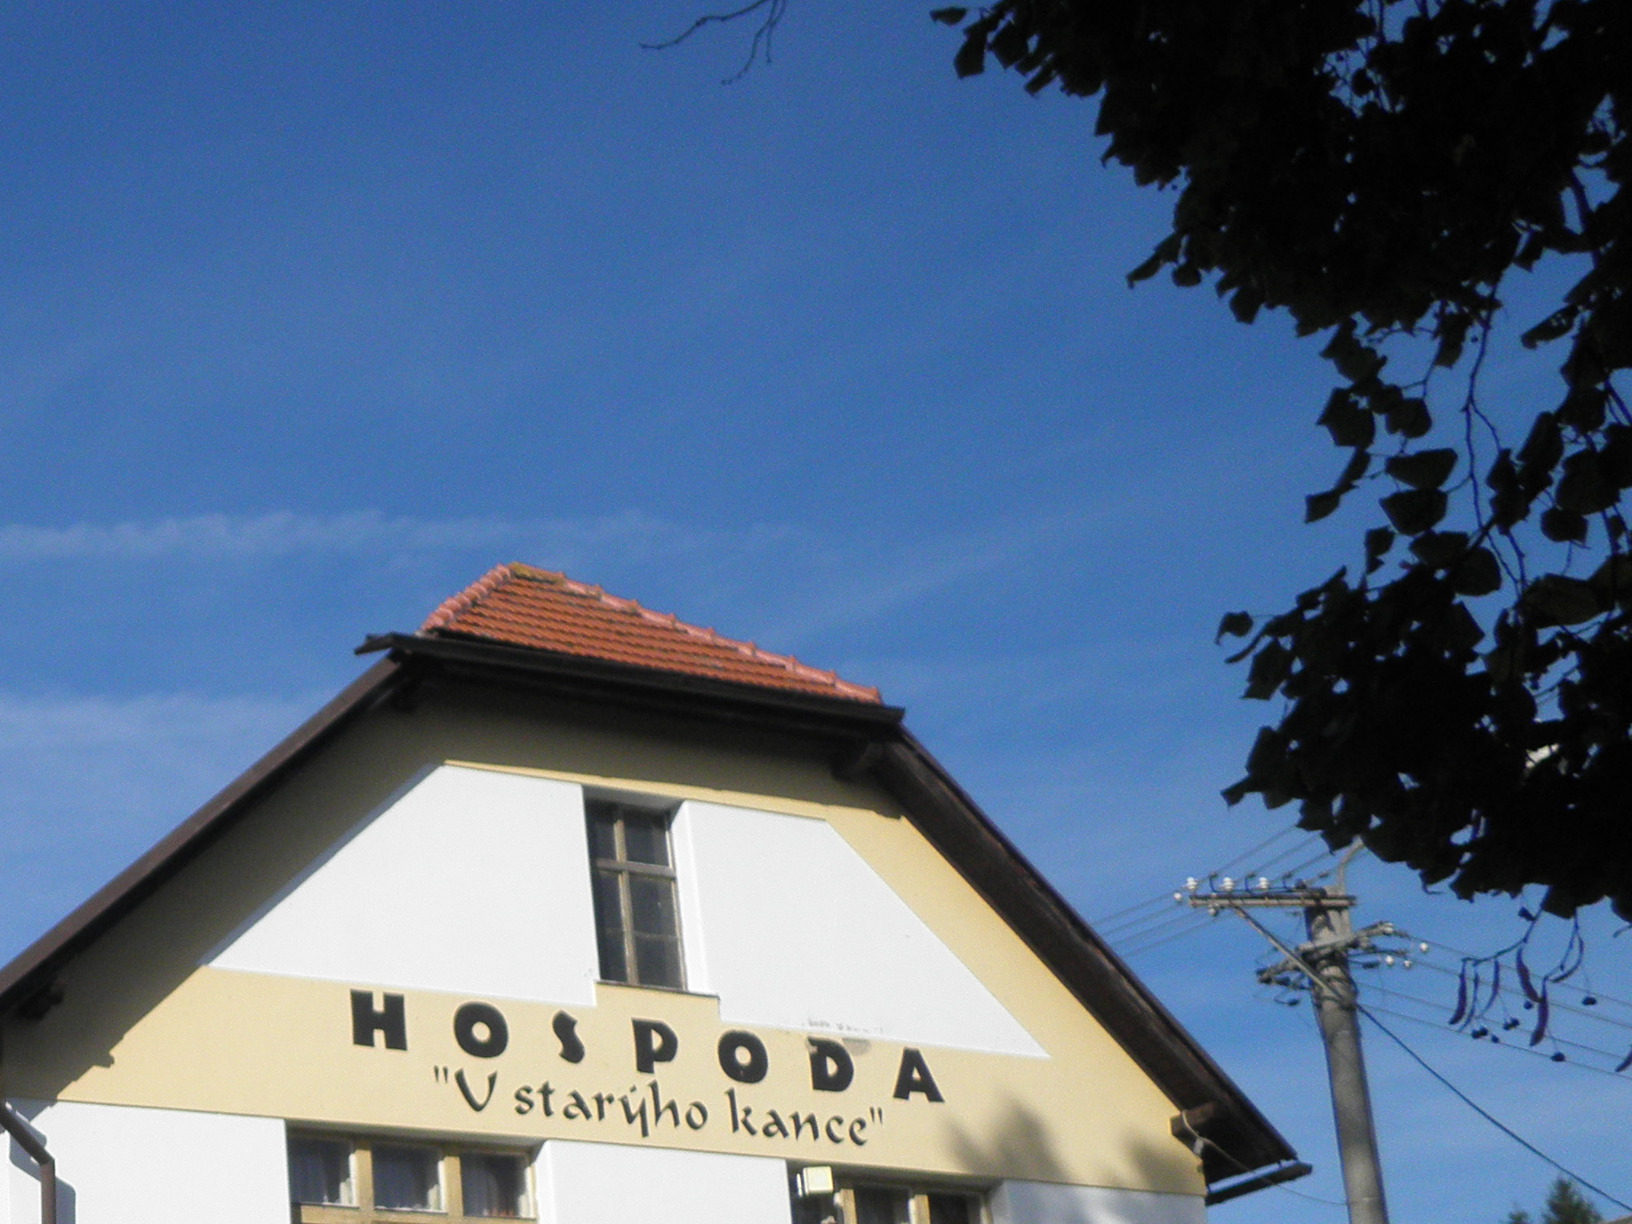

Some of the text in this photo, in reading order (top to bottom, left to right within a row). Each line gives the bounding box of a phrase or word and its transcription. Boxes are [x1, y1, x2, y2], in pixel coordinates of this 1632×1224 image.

[350, 988, 945, 1102] HOSPODA
[514, 1079, 708, 1138] starýho
[725, 1087, 883, 1146] kance"
